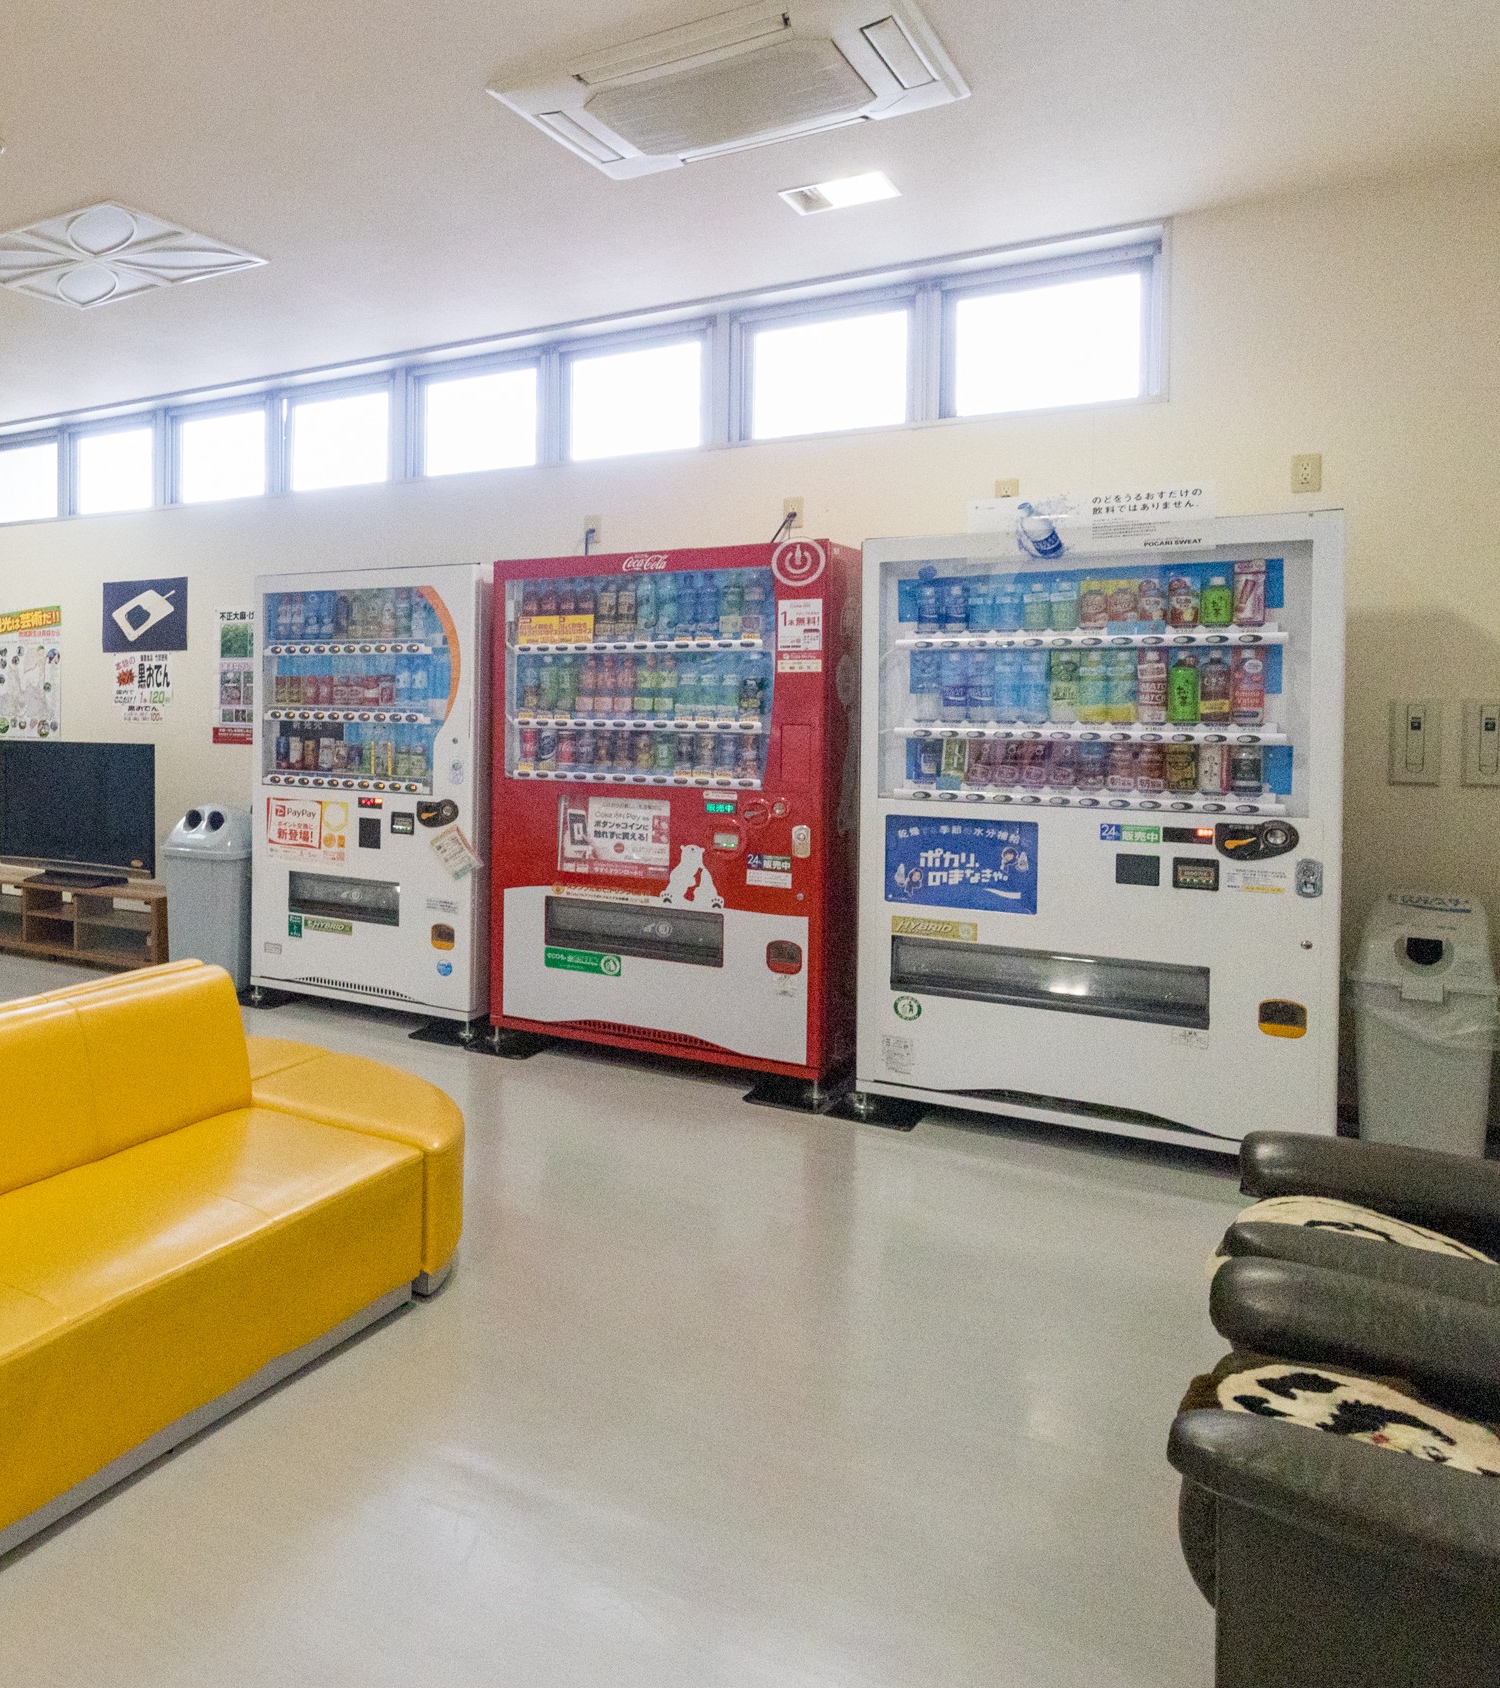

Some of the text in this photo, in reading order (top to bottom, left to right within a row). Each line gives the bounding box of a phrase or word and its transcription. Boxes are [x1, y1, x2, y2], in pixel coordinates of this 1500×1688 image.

[1091, 488, 1203, 505] のどをうるおすだけの
[1143, 538, 1202, 547] POCARI SWEAT
[622, 554, 669, 572] Coca-Cola
[137, 662, 171, 689] 黒おでん
[286, 806, 317, 819] PayPay
[706, 803, 734, 813] 販売中
[594, 820, 649, 831] ボタンやコインに
[1101, 824, 1117, 837] 24
[276, 829, 315, 844] 新登場!
[1121, 830, 1159, 843] 販売中
[747, 853, 761, 865] 24
[762, 859, 791, 870] 販売中
[927, 868, 1009, 887] のまなきゃ。
[896, 920, 953, 934] HYBRID
